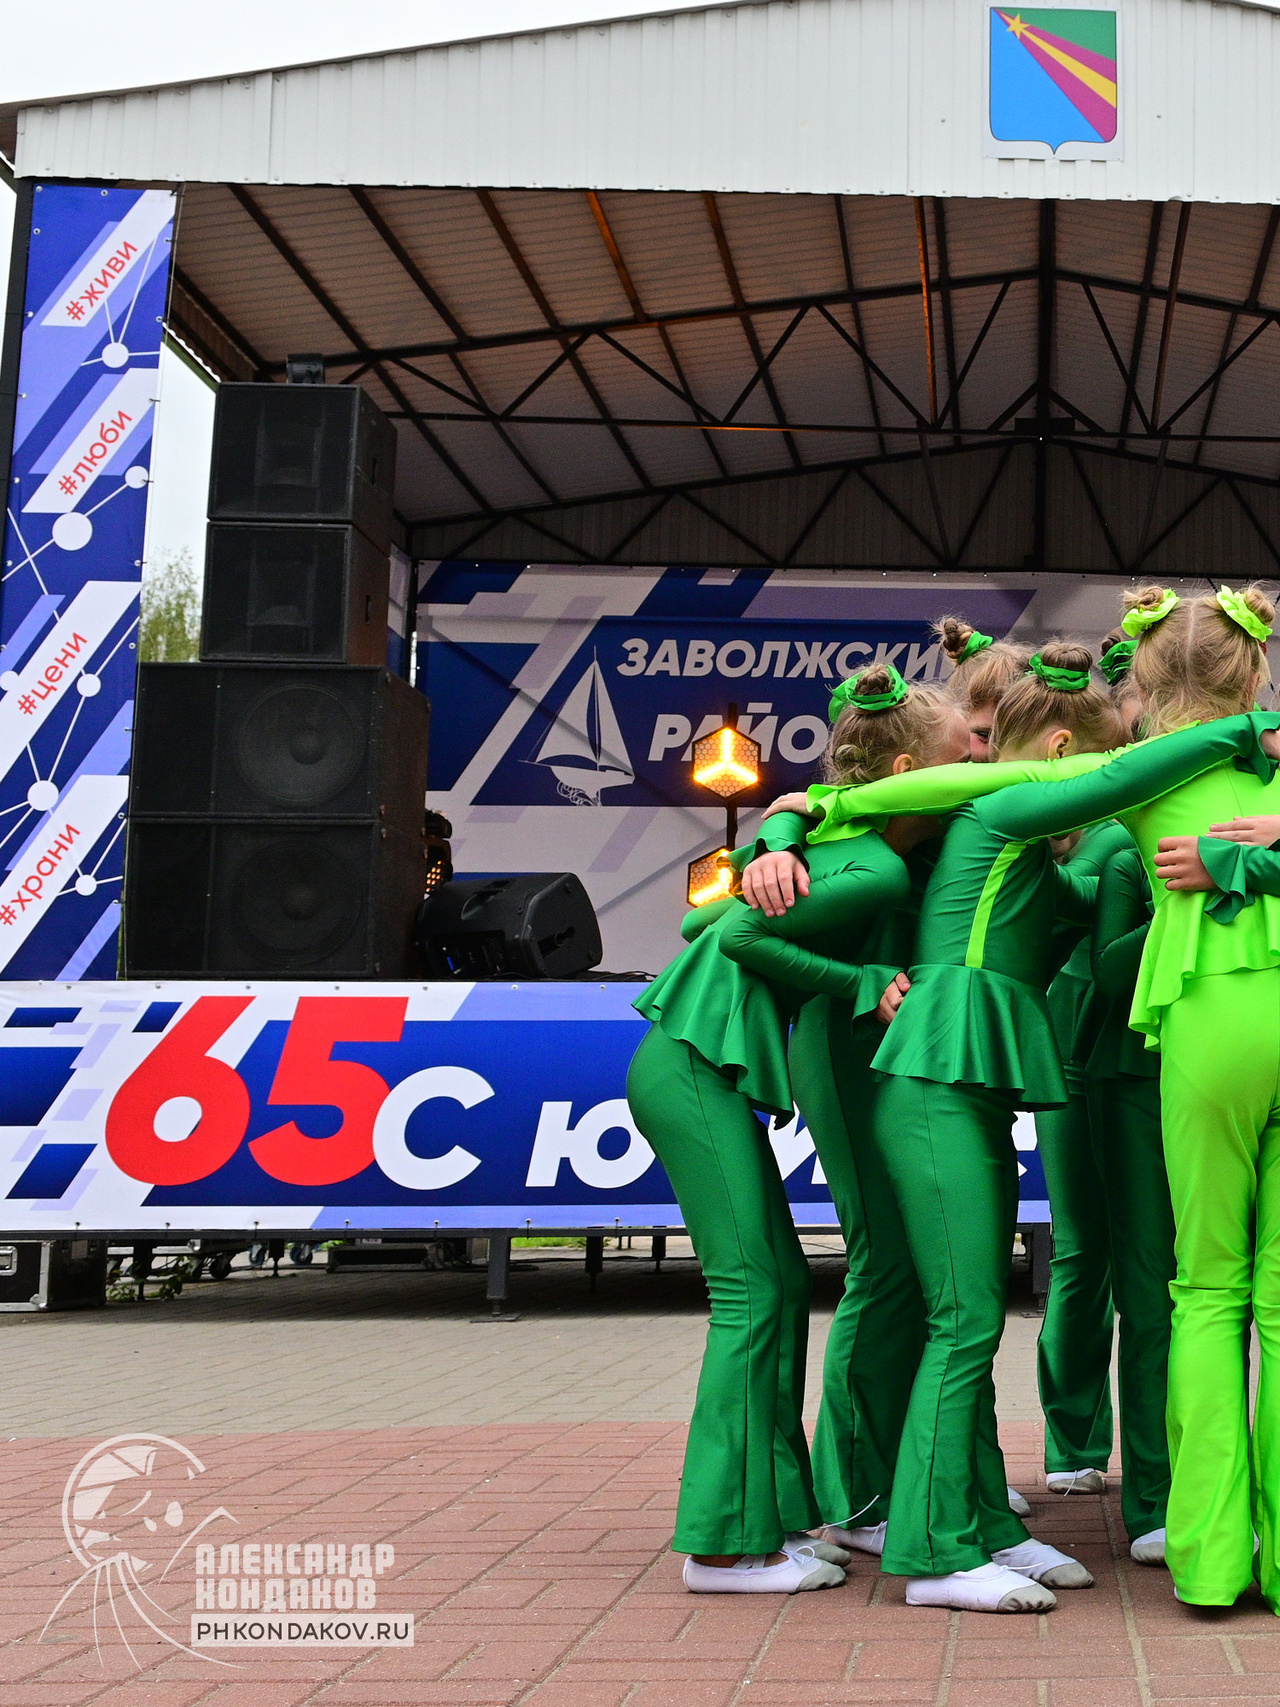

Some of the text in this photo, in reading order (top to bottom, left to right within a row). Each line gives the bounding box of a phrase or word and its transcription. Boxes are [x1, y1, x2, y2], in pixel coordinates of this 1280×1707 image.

[67, 242, 138, 321] #живи
[59, 410, 133, 496] #люби
[18, 632, 88, 715] #цени
[0, 824, 81, 926] #храни
